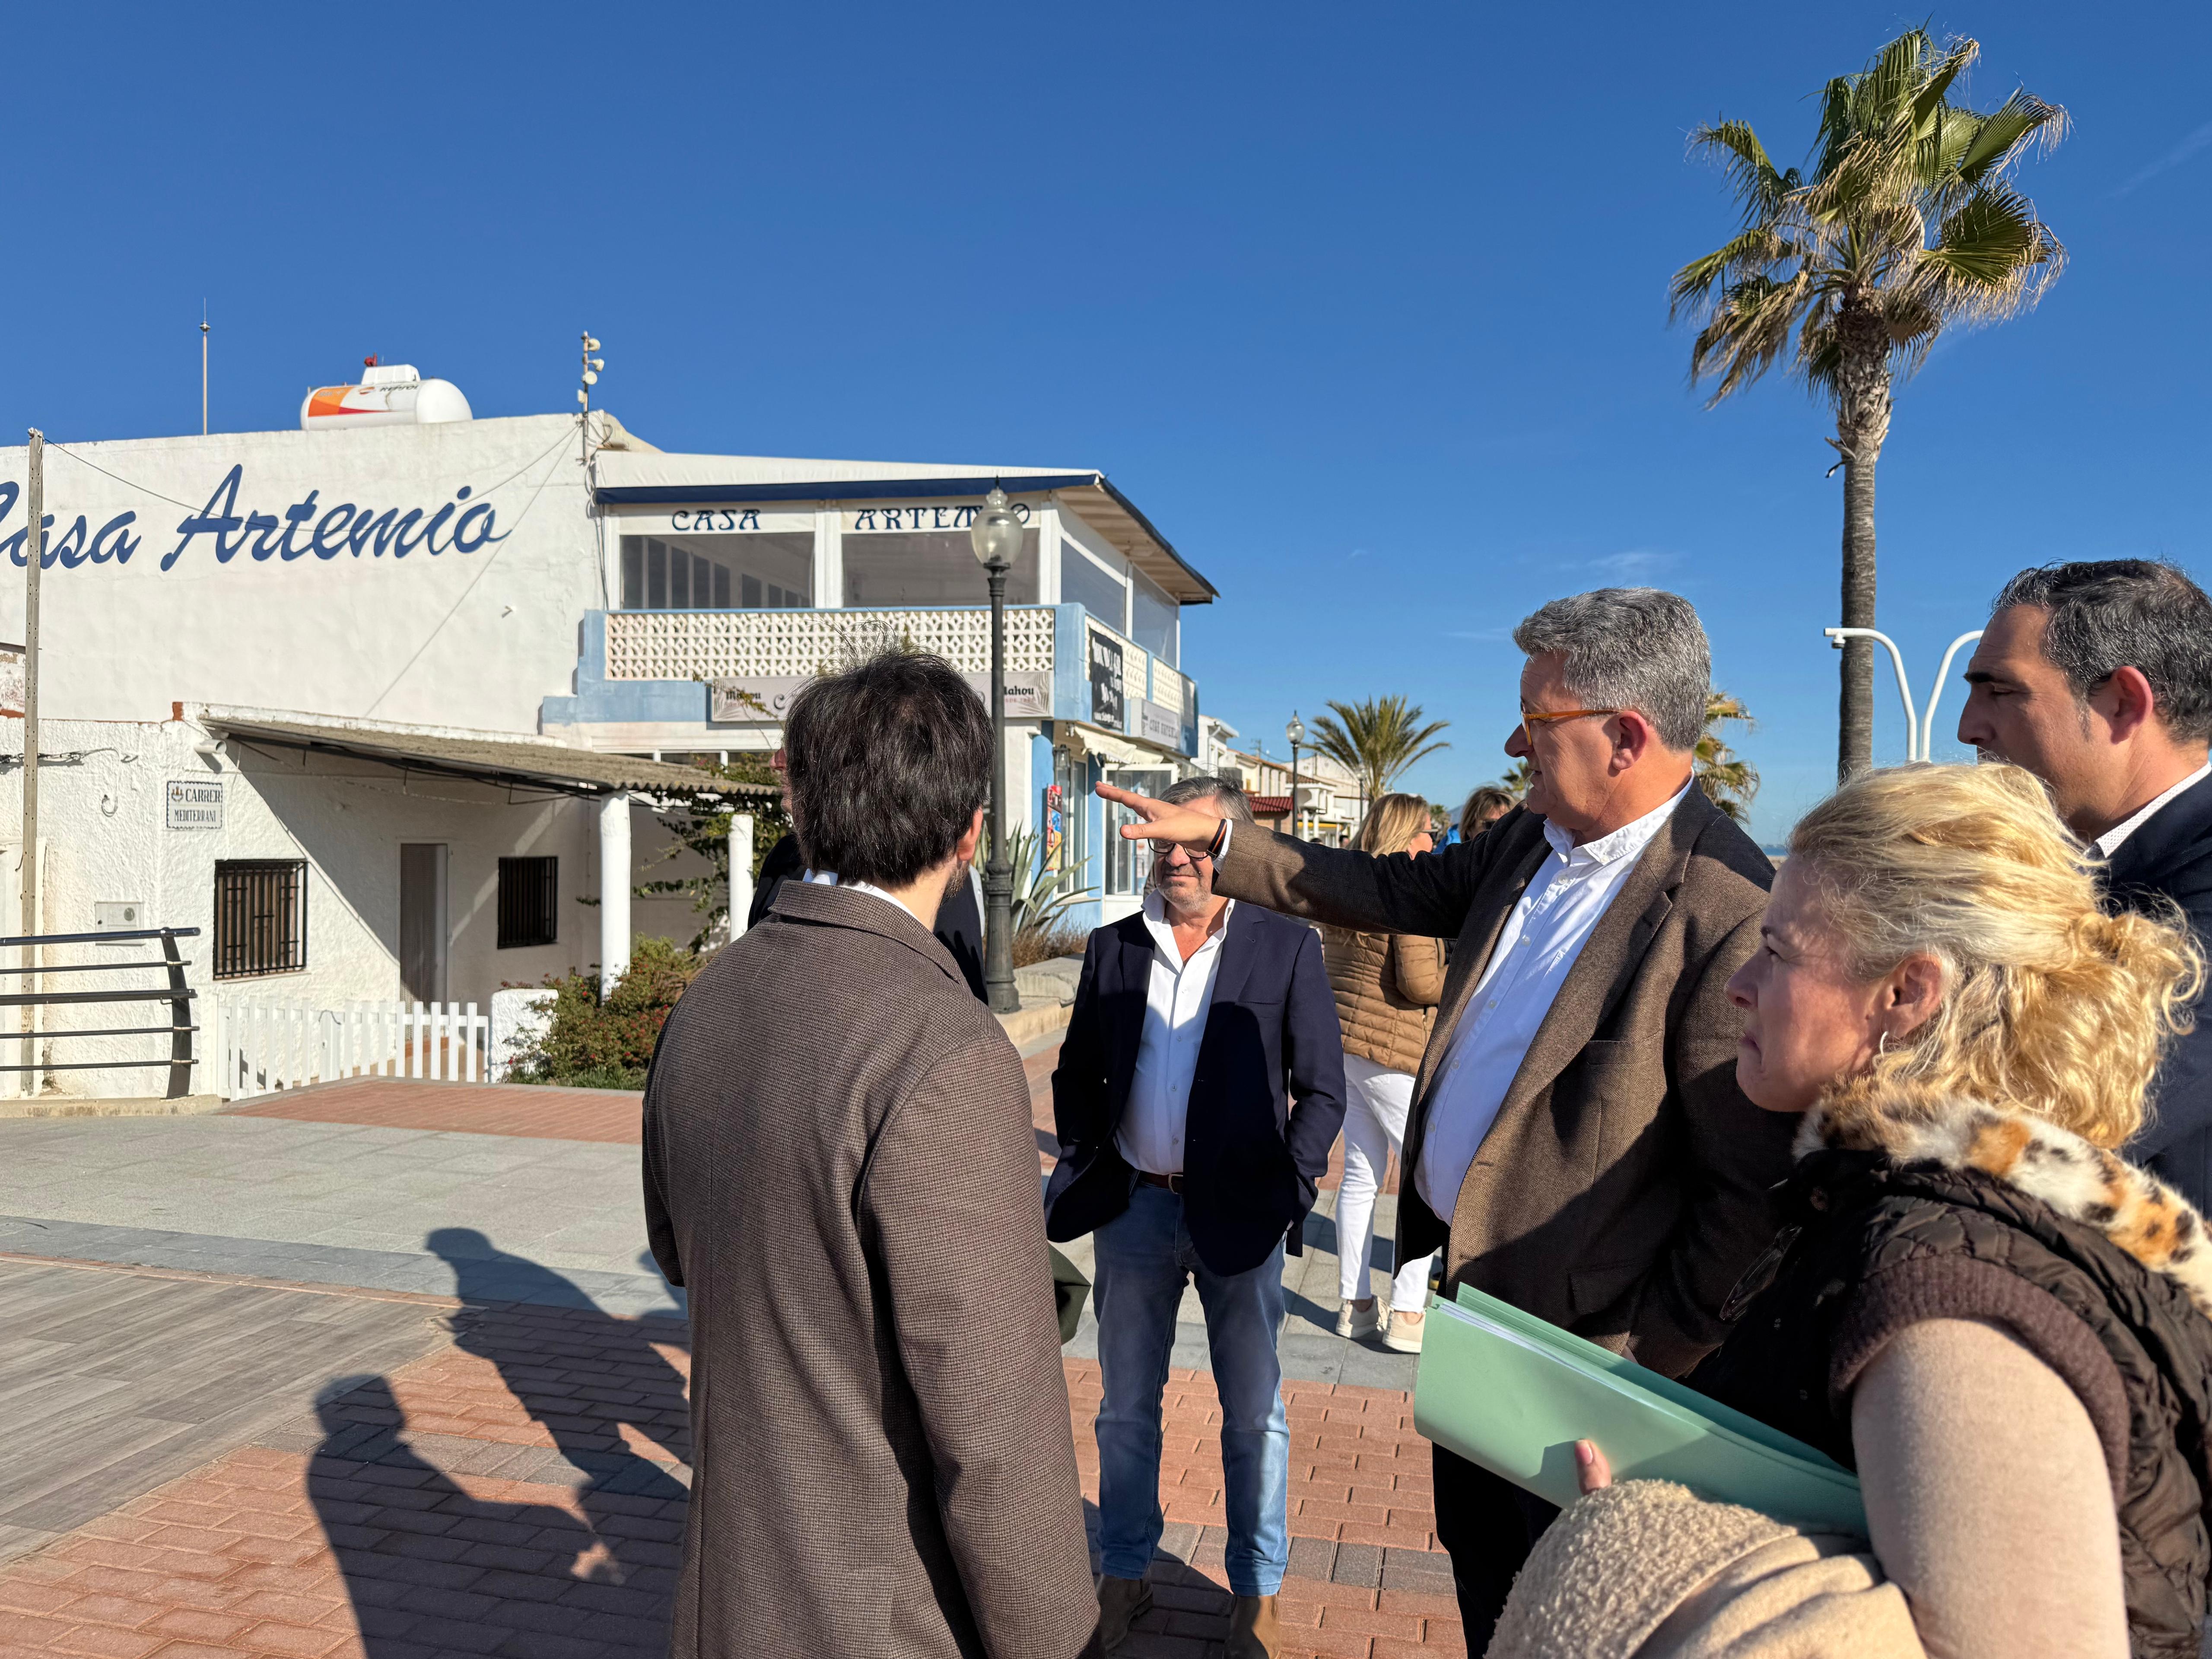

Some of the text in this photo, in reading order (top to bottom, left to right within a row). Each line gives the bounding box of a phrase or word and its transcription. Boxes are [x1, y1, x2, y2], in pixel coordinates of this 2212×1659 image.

[160, 464, 513, 572] Artemio
[672, 503, 1030, 531] CASA ARTEMO
[185, 788, 220, 803] CARRER
[174, 809, 216, 822] MEDITERRANI
